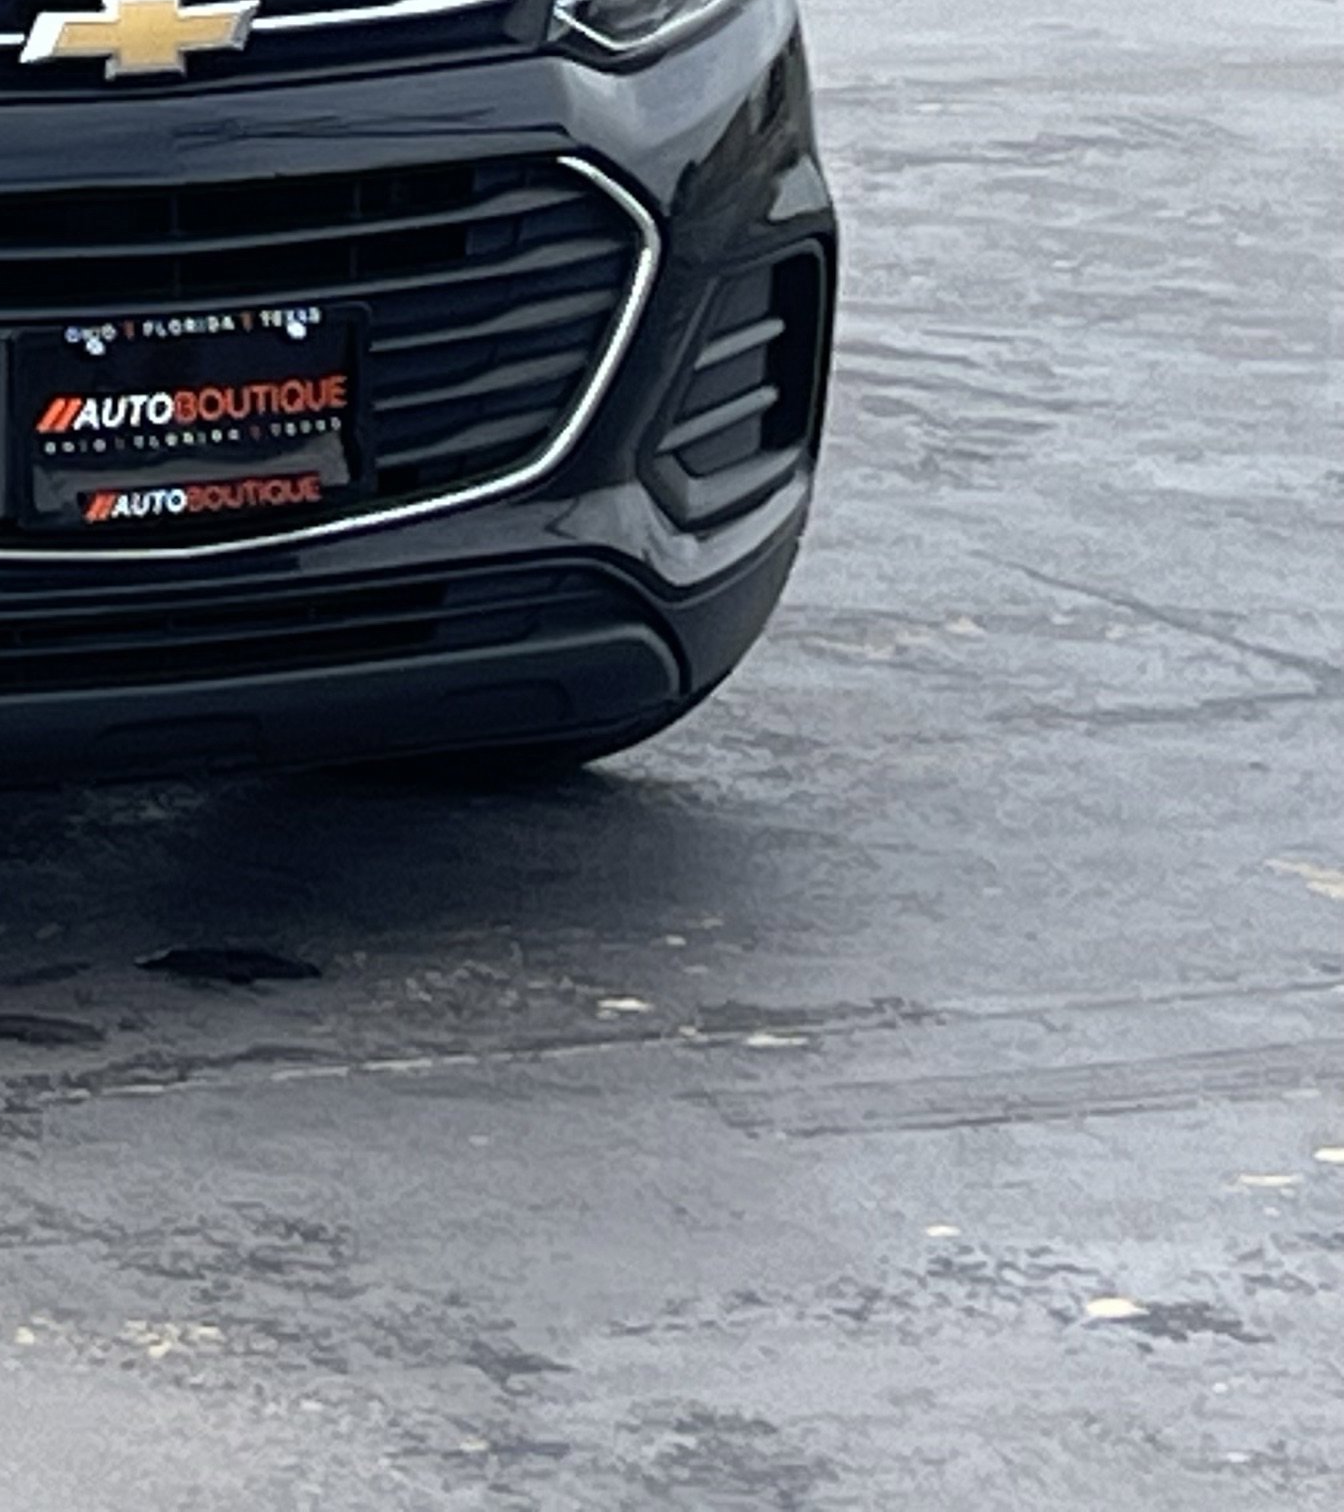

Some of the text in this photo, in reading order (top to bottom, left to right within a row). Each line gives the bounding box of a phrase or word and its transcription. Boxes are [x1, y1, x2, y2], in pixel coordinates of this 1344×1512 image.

[142, 315, 235, 339] FLORIDA
[72, 374, 348, 431] AUTOBOUTIQUE
[110, 472, 322, 519] AUTOBOUTIQUE
